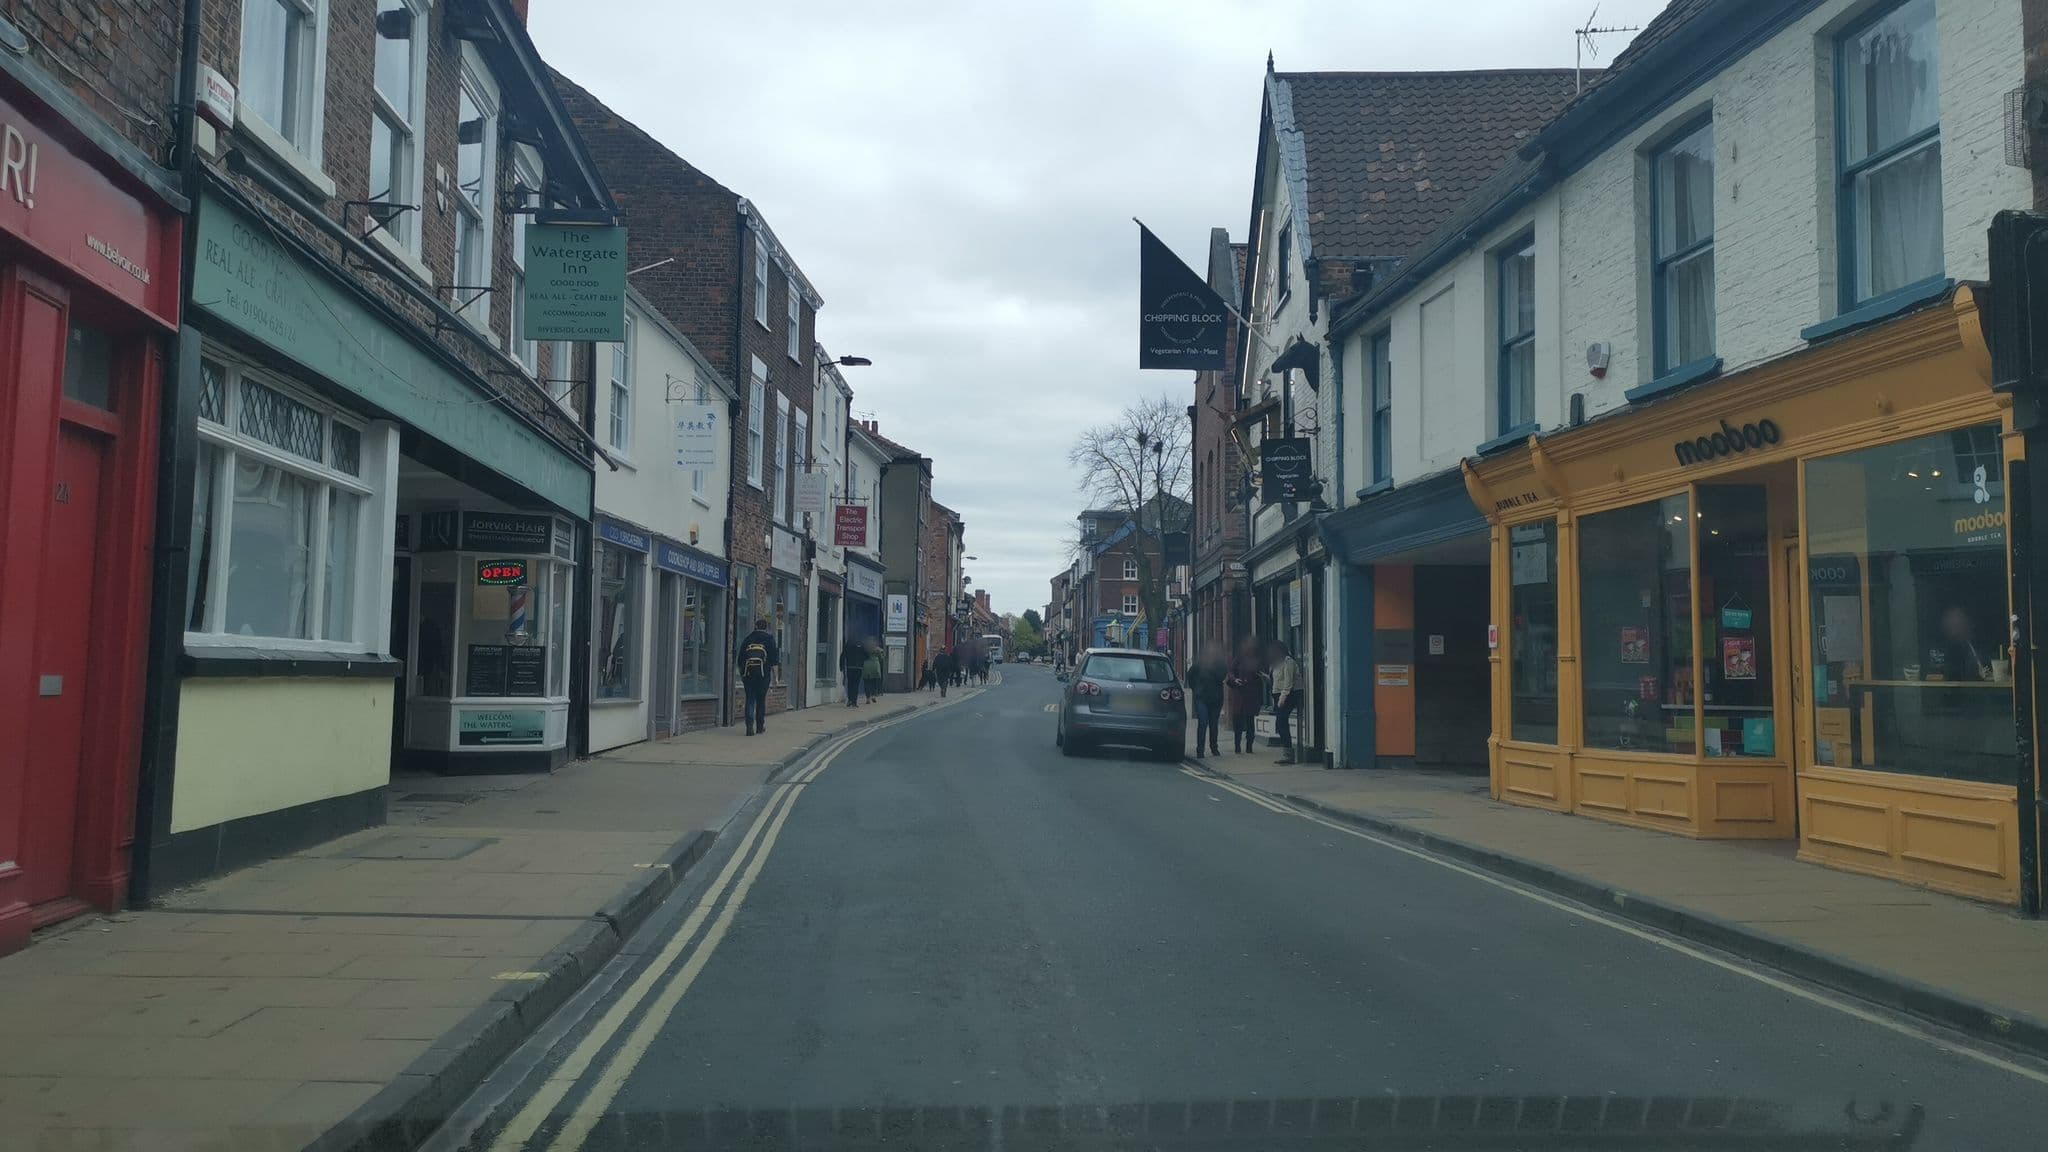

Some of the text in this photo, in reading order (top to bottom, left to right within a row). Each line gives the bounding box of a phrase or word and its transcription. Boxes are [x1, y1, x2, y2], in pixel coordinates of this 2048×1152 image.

[562, 231, 590, 243] The
[532, 245, 618, 262] Watergate
[206, 238, 233, 275] REAL
[235, 259, 256, 289] ALE
[562, 262, 588, 274] Inn
[550, 279, 599, 288] GOOD FOOD
[529, 293, 618, 302] REAL ALE CRAFT BEER
[1191, 314, 1222, 323] BLOCK
[538, 326, 577, 334] RIVERSIDE
[1150, 347, 1181, 355] Vegetarian
[1186, 347, 1199, 355] Fish
[1674, 418, 1780, 467] mooboo
[1495, 491, 1539, 511] BUBBLE TEA
[839, 516, 863, 524] Electric
[468, 519, 546, 533] JORVIK HAIR
[836, 524, 866, 533] Transport
[841, 532, 859, 541] Shop
[1967, 535, 1987, 543] BUBBLE
[482, 565, 521, 579] OPEN
[477, 713, 513, 721] WELCOM
[463, 721, 478, 729] THE
